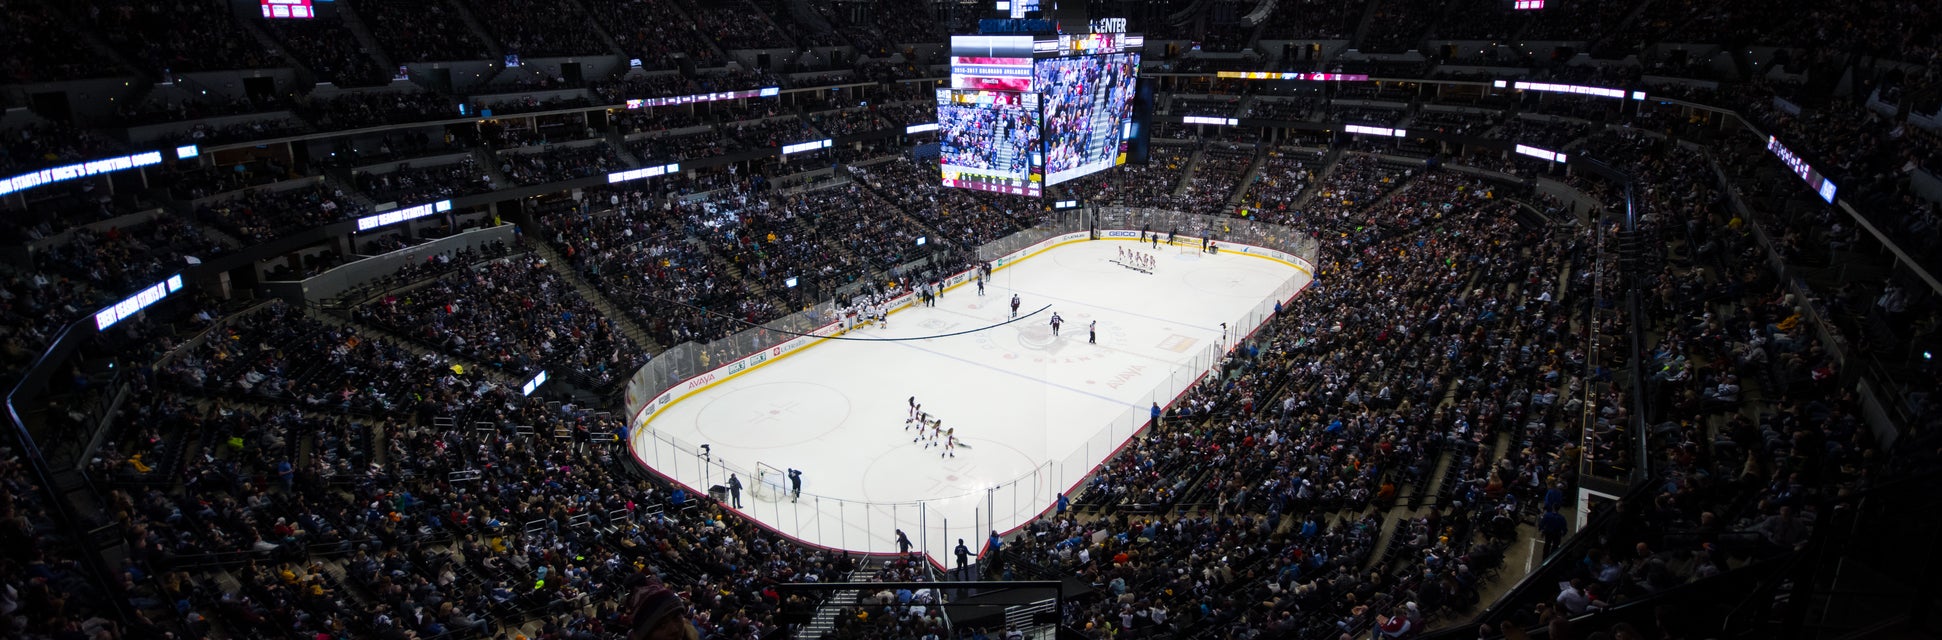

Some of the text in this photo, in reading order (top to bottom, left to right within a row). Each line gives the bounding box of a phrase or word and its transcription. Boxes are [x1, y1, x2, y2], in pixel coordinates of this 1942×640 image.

[40, 169, 52, 184] AT
[51, 164, 86, 182] DICK'S
[85, 156, 132, 175] SPORTING
[424, 203, 433, 215] AT
[96, 306, 117, 331] EVERY
[115, 295, 140, 320] SEASON
[137, 285, 160, 309] STARTS
[158, 282, 167, 298] AT
[689, 374, 715, 390] AVAYA
[1107, 364, 1146, 389] AVAYA
